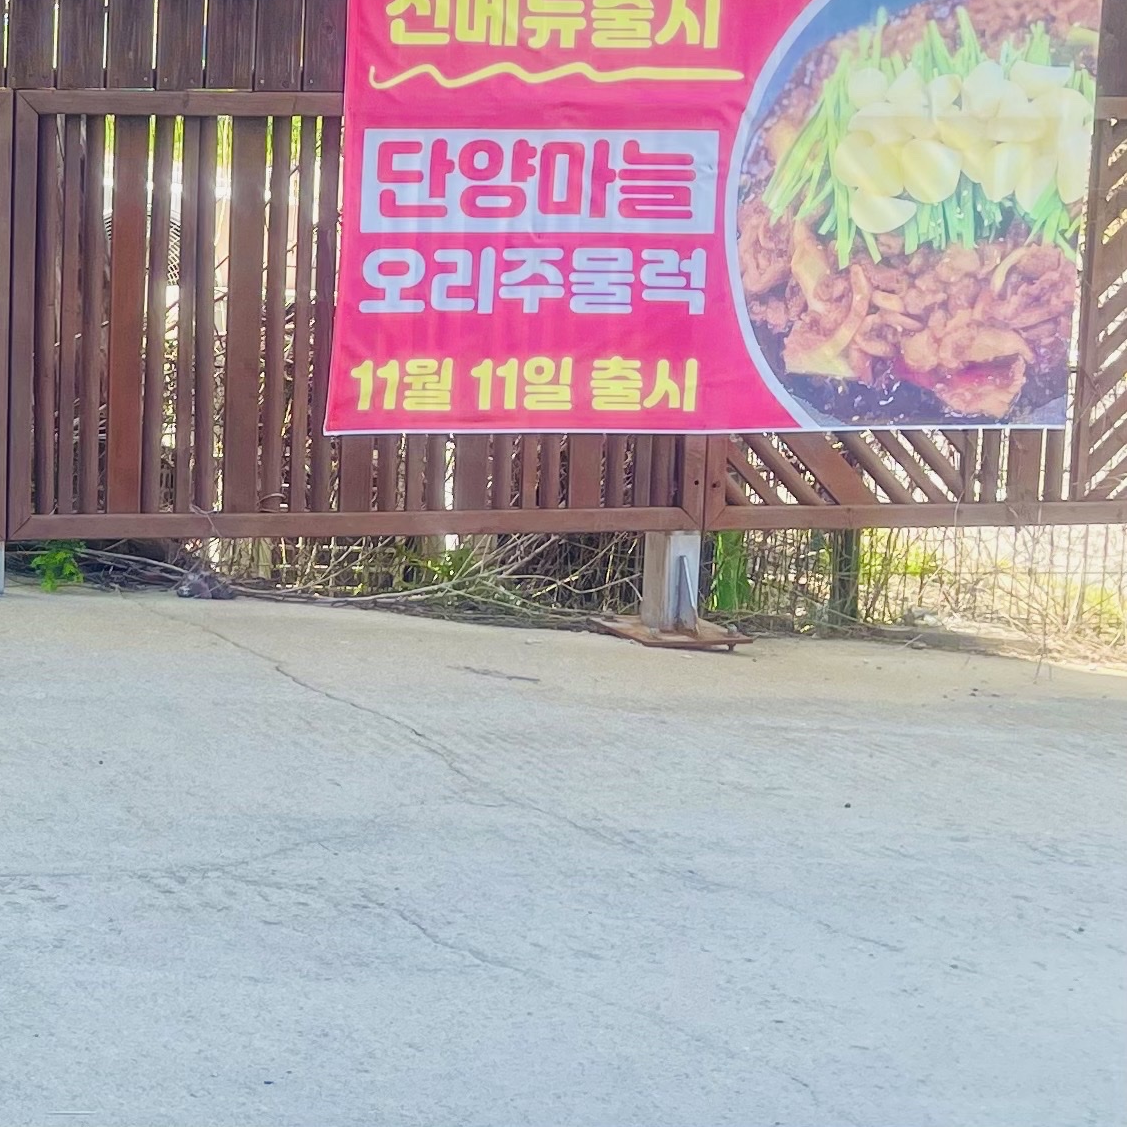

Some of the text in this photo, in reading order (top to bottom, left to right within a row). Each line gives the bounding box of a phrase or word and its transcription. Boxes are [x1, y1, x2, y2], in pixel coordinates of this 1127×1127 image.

[377, 138, 696, 219] 단양마늘
[358, 247, 707, 314] 오리주물럭
[351, 355, 698, 411] 11월 11일 출시
